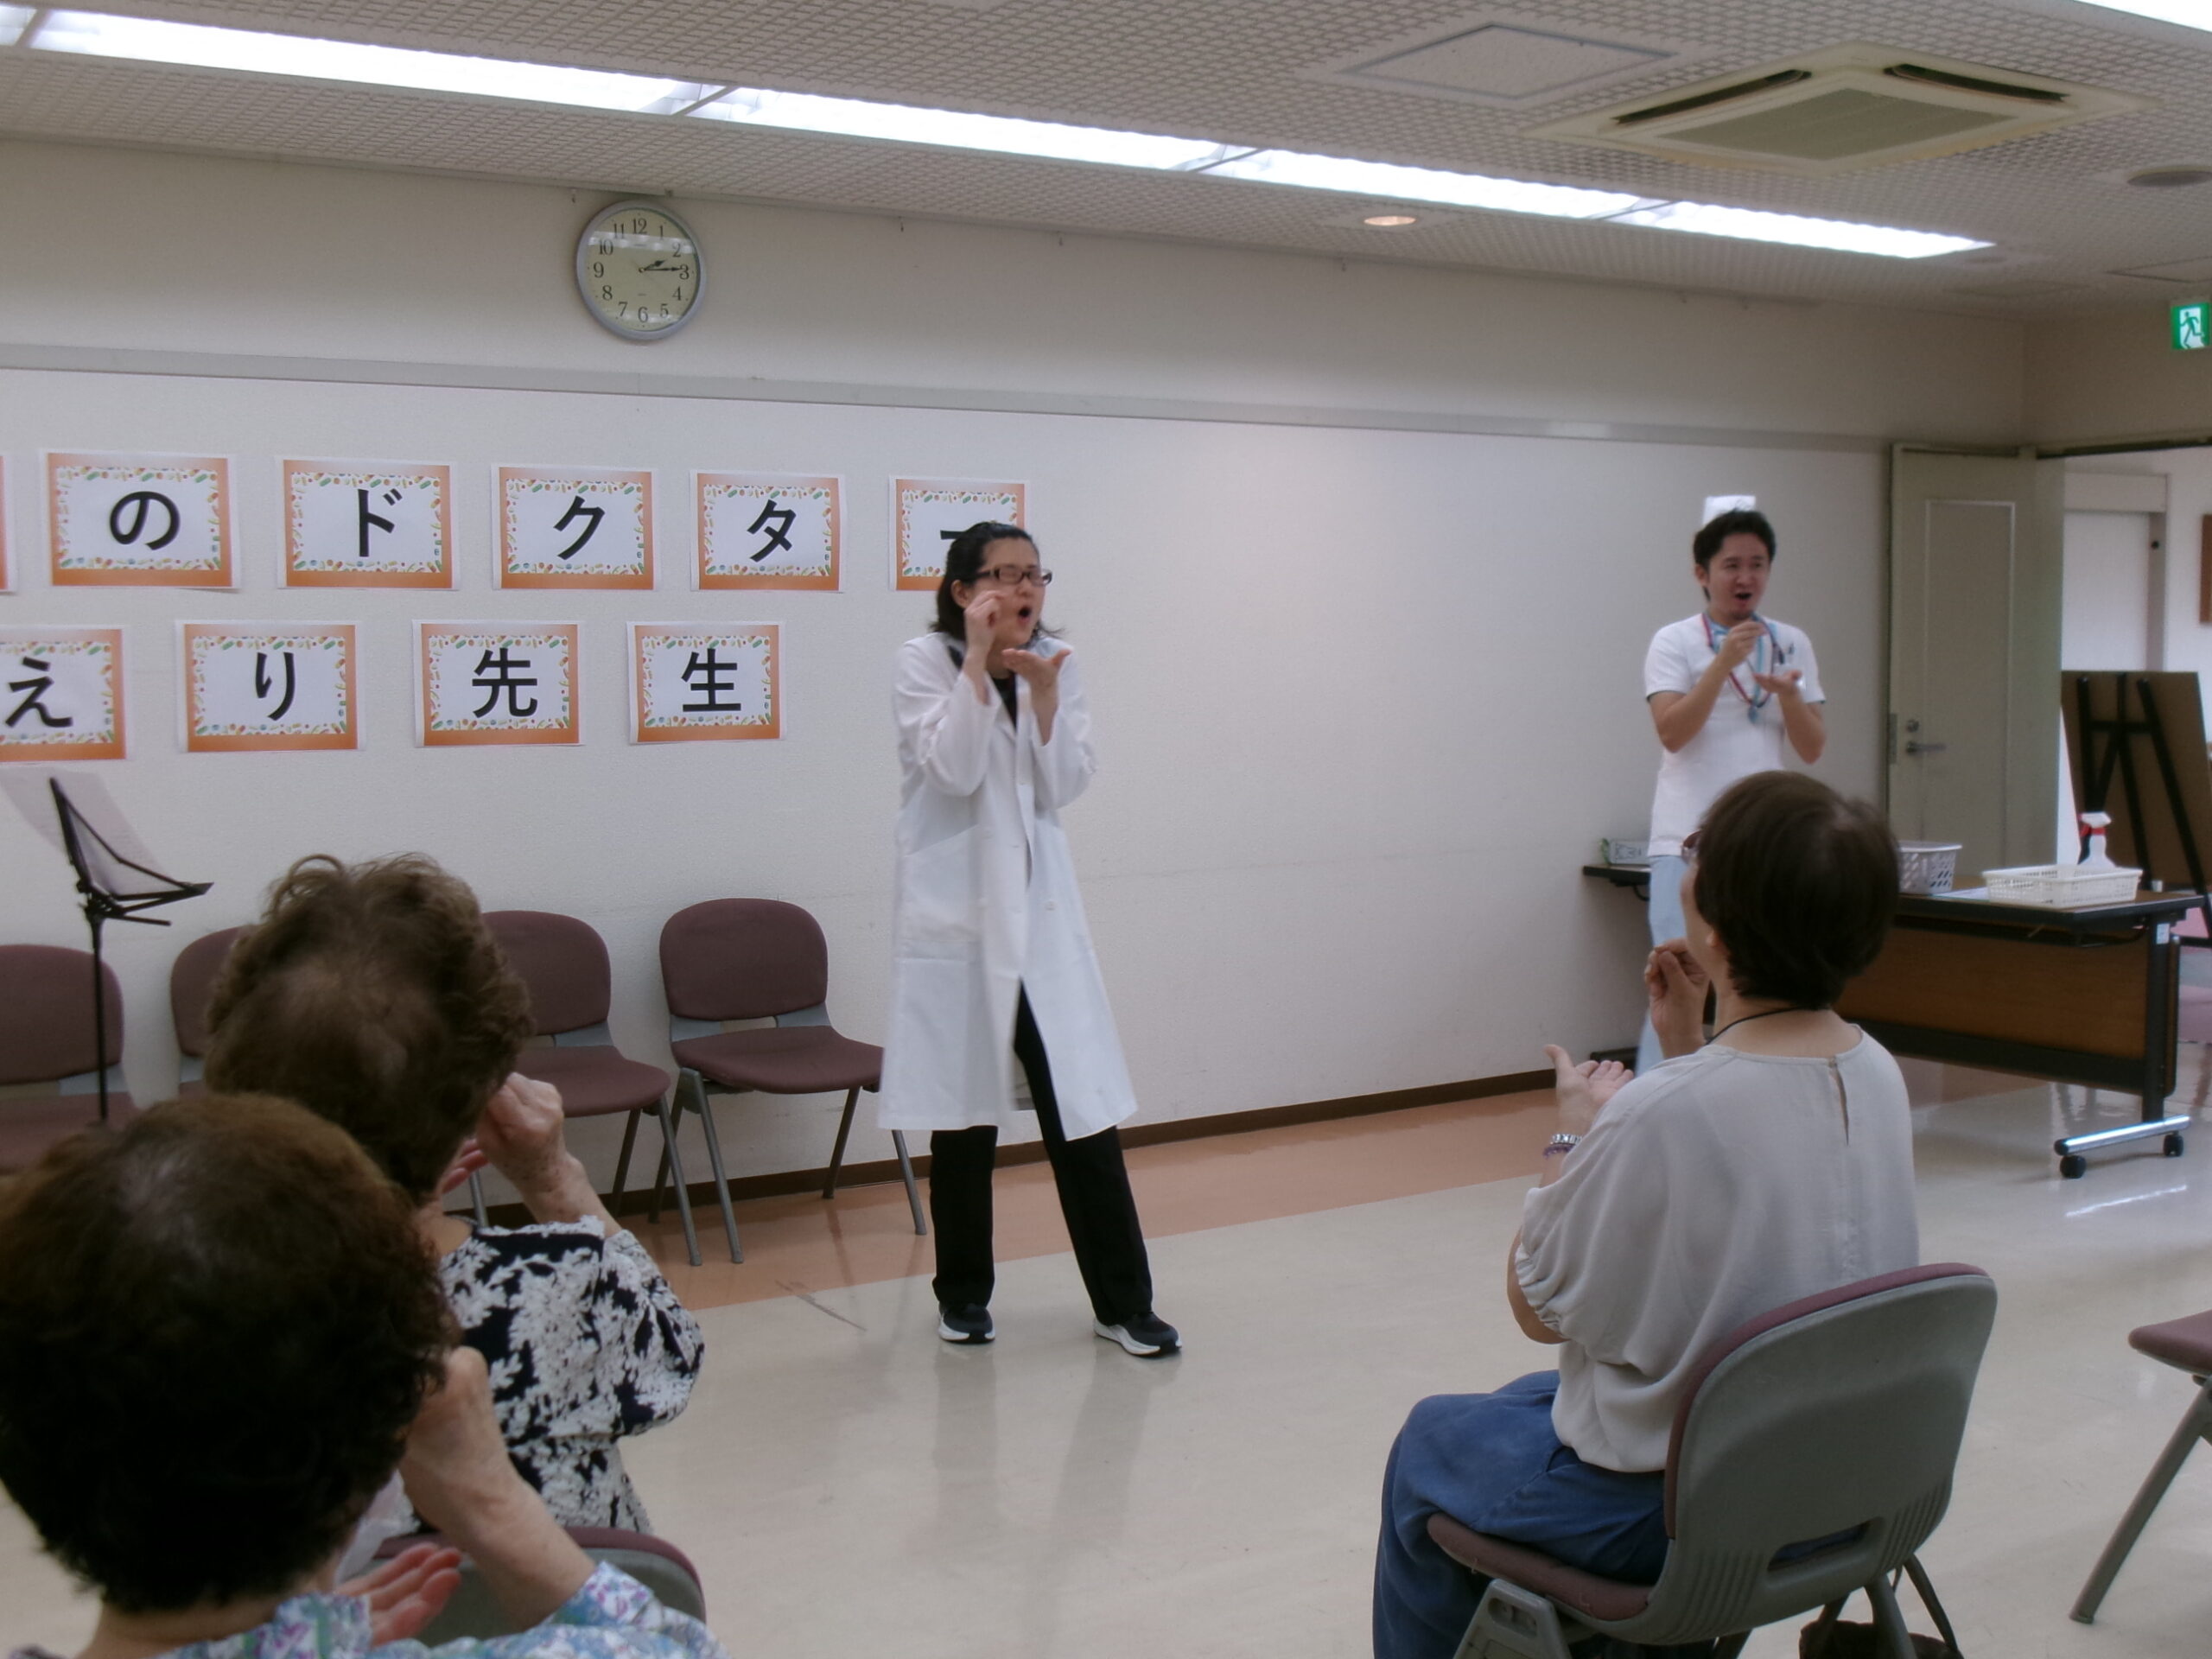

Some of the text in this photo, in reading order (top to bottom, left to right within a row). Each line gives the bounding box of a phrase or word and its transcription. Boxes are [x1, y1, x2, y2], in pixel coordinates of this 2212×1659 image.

[613, 224, 626, 239] 11
[632, 218, 647, 234] 12
[659, 225, 664, 241] 1
[599, 239, 613, 255] 10
[672, 242, 681, 257] 2
[593, 262, 604, 278] 9
[679, 264, 690, 280] 3
[602, 285, 613, 301] 8
[672, 286, 682, 301] 4
[618, 302, 628, 317] 7
[638, 307, 649, 322] 6
[660, 303, 669, 318] 5
[110, 491, 181, 550] の
[358, 488, 403, 557] ド
[554, 495, 605, 560] ク
[747, 499, 797, 563] タ
[5, 647, 741, 728] え り 先 生
